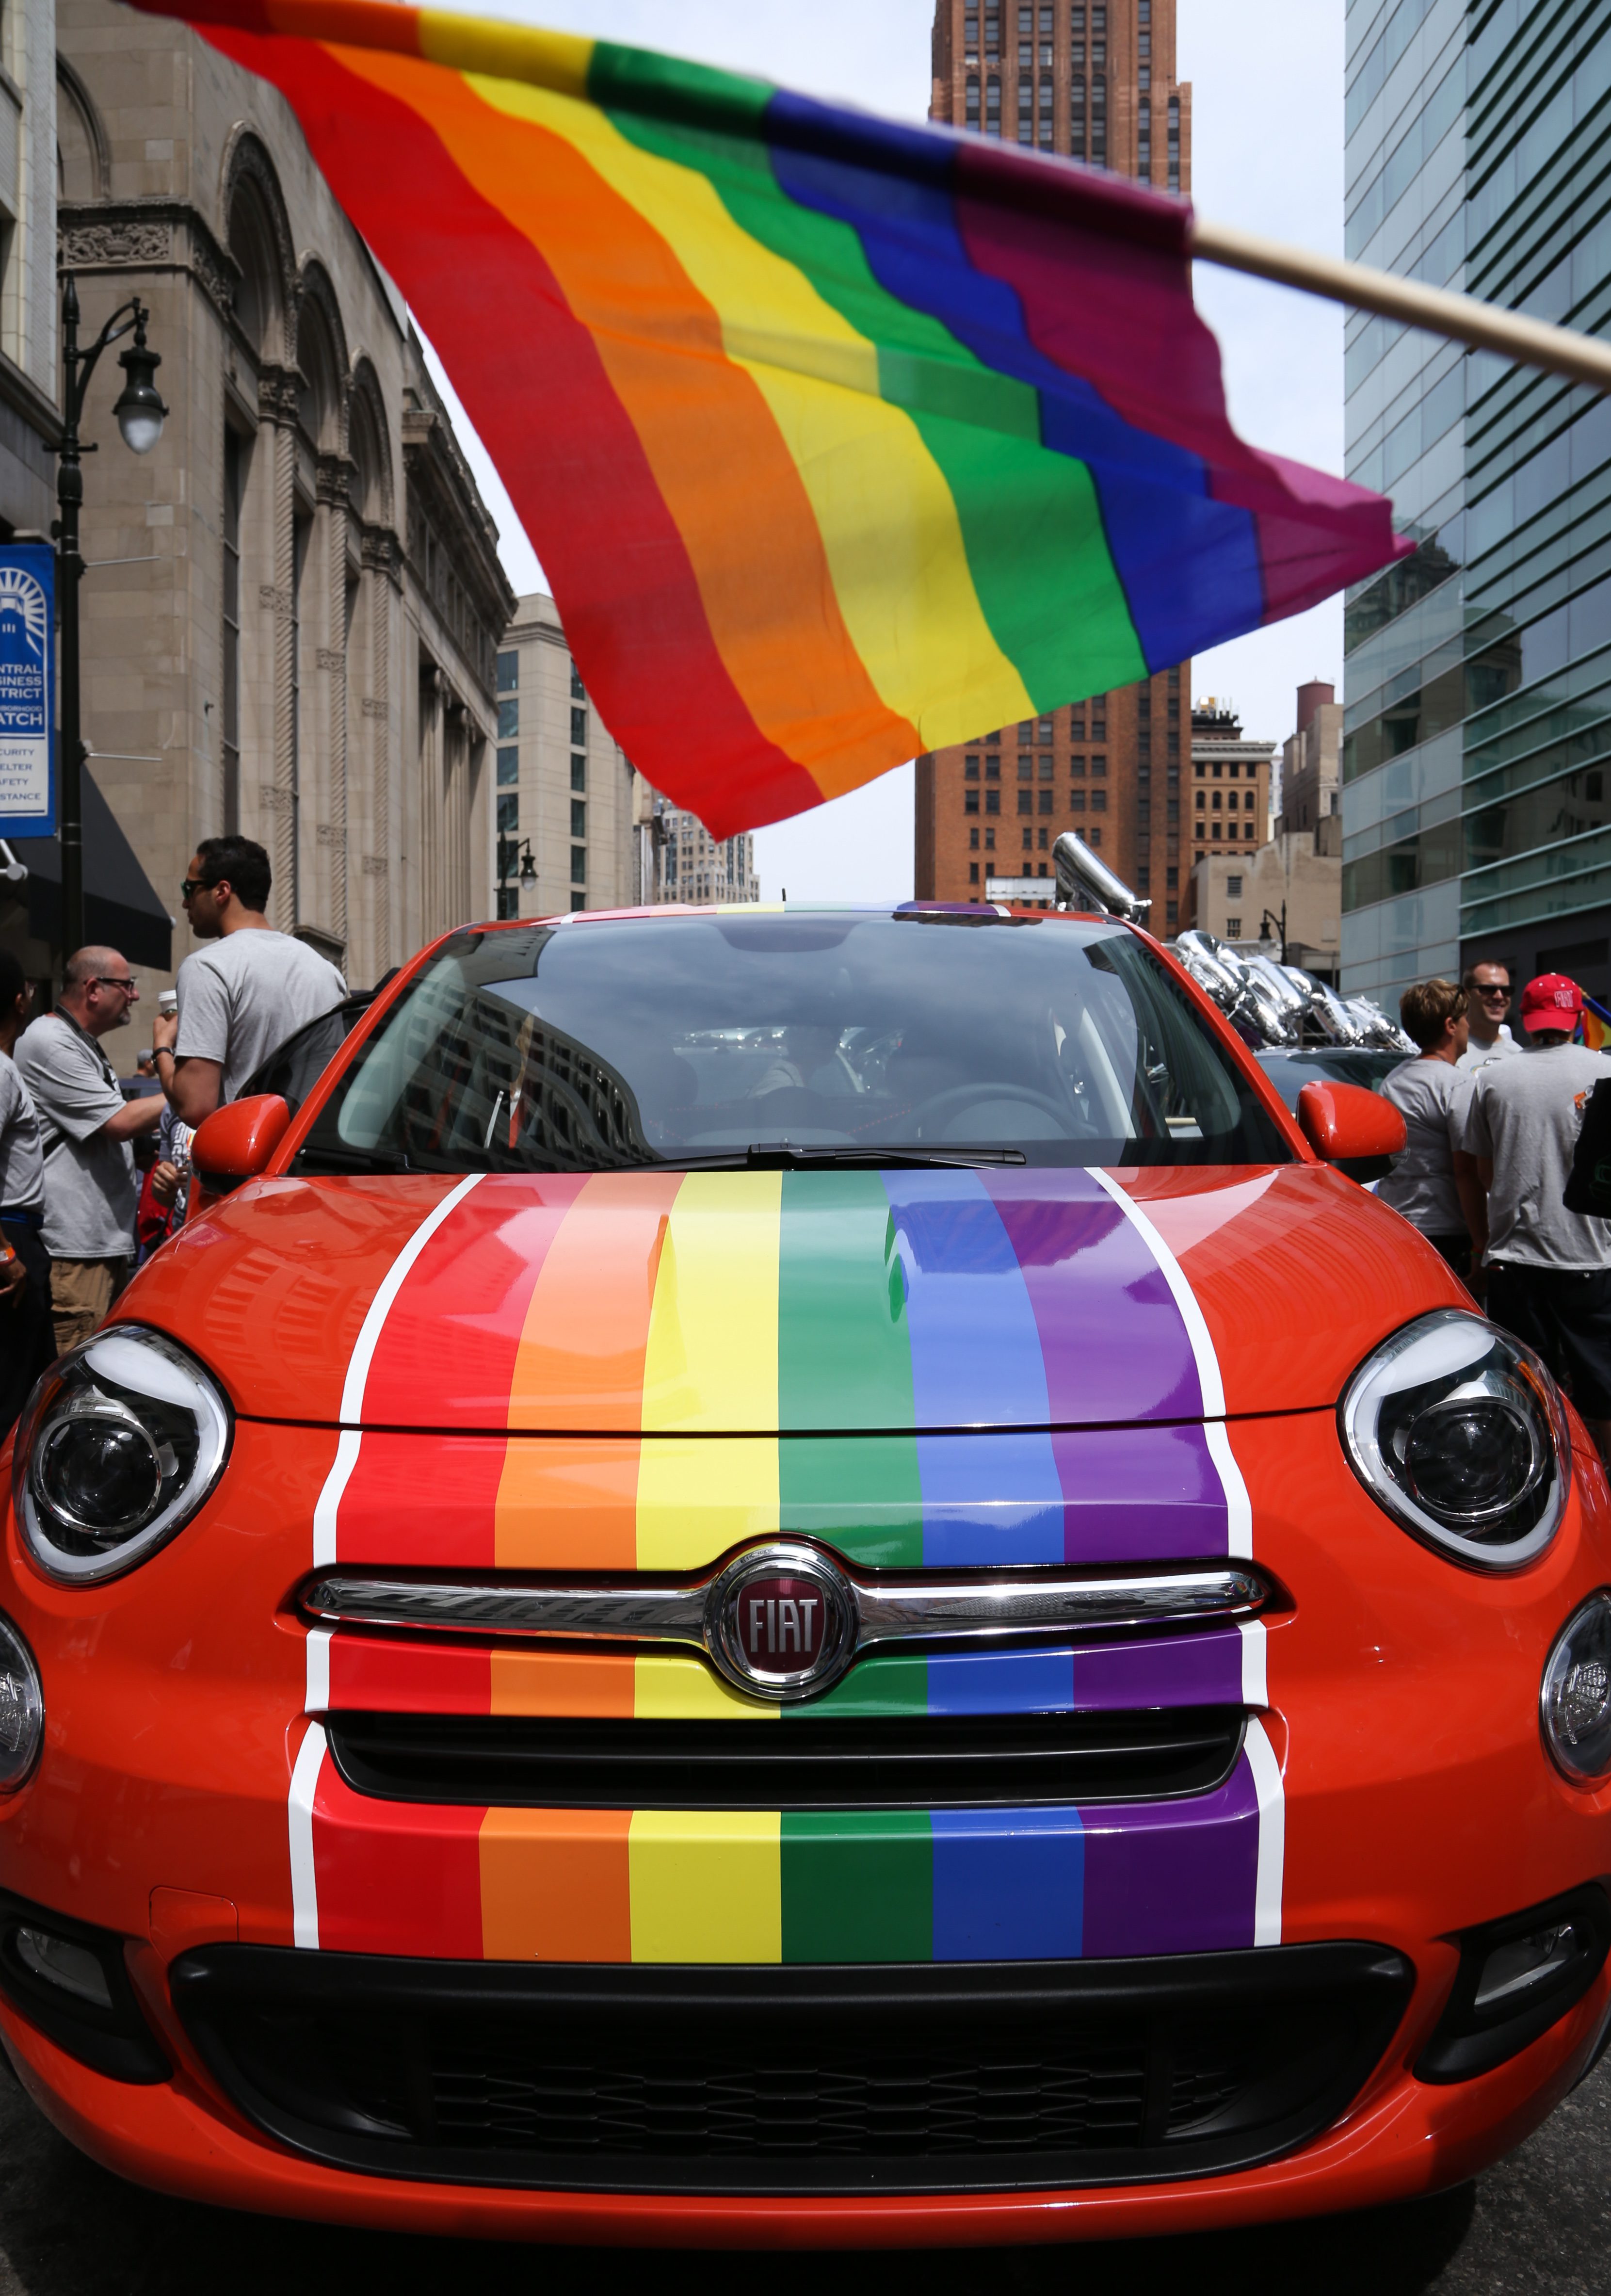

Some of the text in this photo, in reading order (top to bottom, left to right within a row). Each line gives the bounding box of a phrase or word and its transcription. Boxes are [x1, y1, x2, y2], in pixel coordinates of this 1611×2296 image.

[0, 688, 42, 698] TRICT
[1554, 990, 1573, 1007] FIAT
[750, 1600, 818, 1653] FIAT
